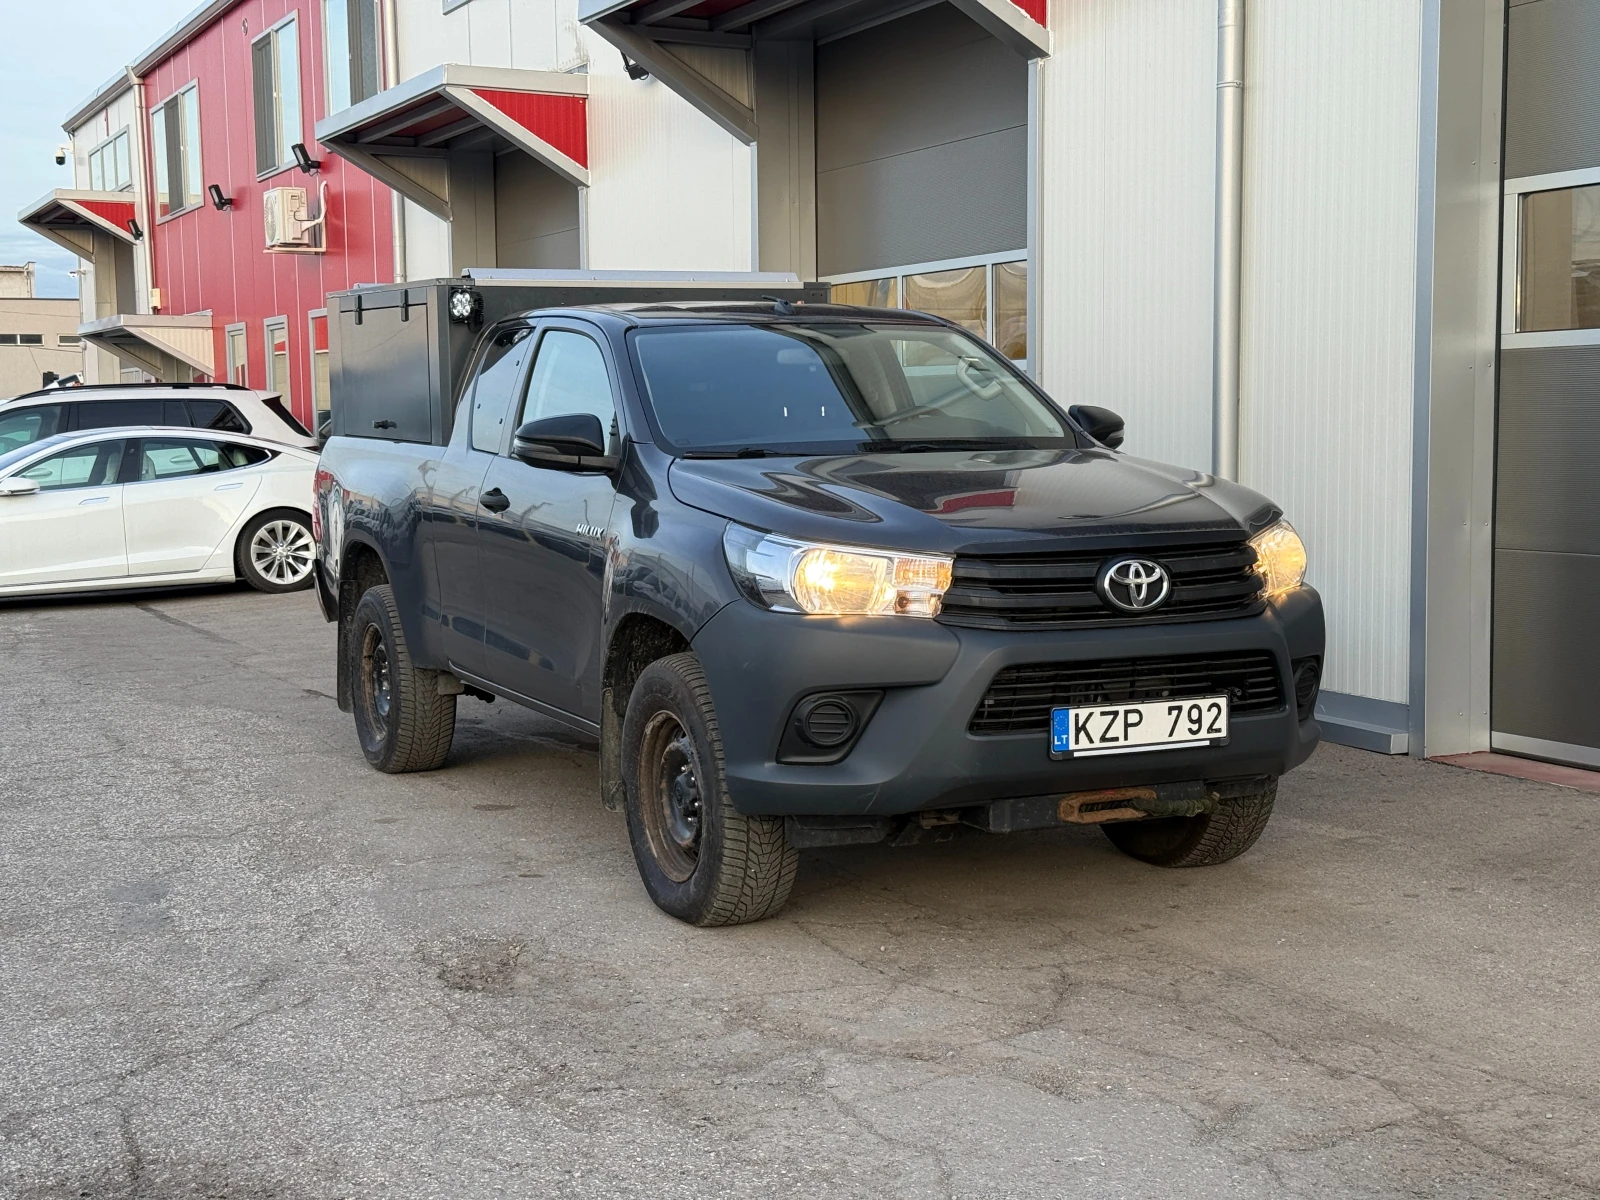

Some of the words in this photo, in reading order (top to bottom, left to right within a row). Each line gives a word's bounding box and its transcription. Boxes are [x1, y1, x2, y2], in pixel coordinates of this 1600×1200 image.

[576, 523, 604, 541] HILUX
[1074, 709, 1143, 745] KZP
[1168, 702, 1222, 737] 792
[1054, 734, 1068, 745] LT
